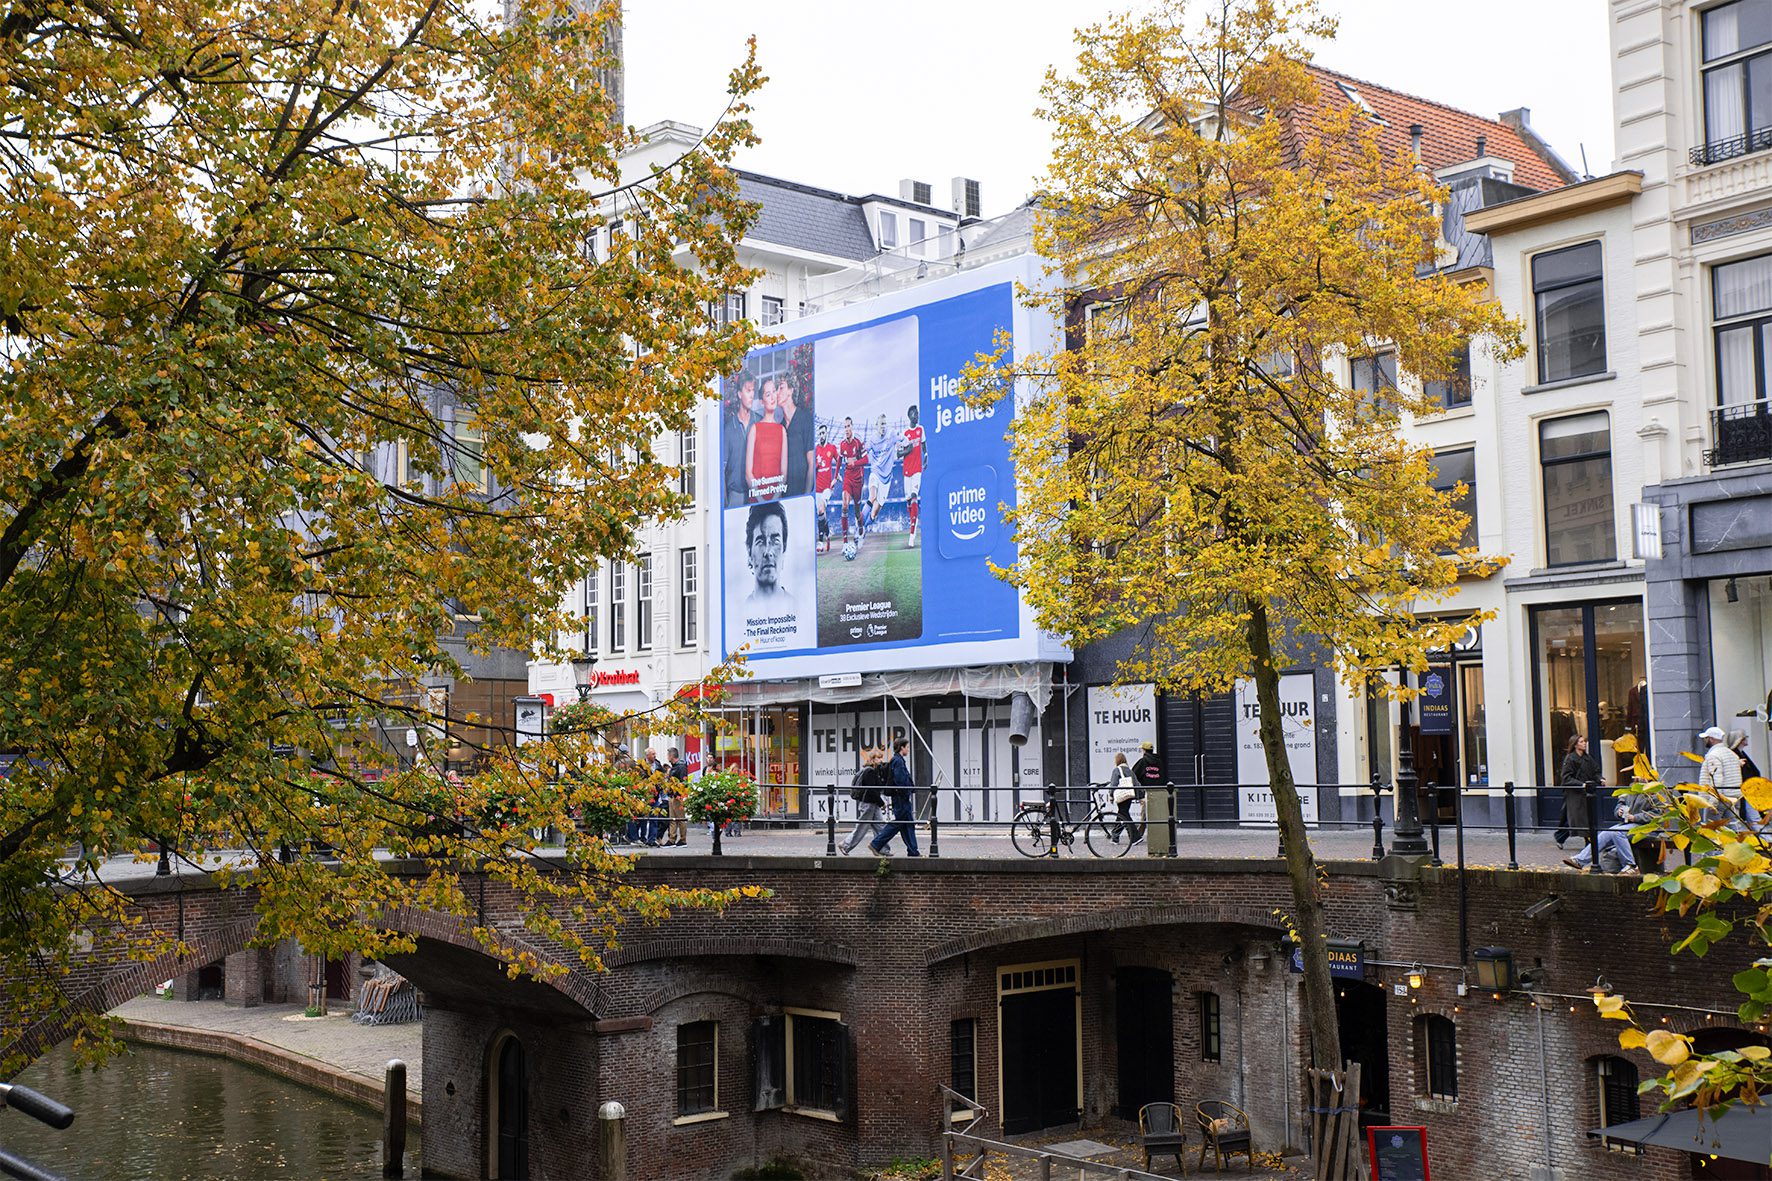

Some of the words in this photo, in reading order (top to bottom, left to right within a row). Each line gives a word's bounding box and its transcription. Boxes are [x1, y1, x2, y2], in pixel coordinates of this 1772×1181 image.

[935, 404, 952, 433] je
[751, 478, 761, 487] The
[761, 475, 785, 485] Summer
[752, 487, 769, 497] Turned
[770, 483, 788, 495] Pretty
[949, 486, 986, 509] prime
[950, 505, 986, 525] video
[846, 602, 869, 612] Premier
[870, 601, 892, 611] League
[746, 617, 768, 626] Mission:
[768, 614, 796, 625] Impossible
[746, 628, 757, 636] The
[757, 626, 770, 636] Final
[770, 625, 797, 635] Reckoning
[600, 669, 640, 684] Kruidvat
[1094, 710, 1110, 724] TE
[1112, 708, 1152, 724] HUUR
[1243, 704, 1261, 718] TE
[813, 729, 837, 753] TE
[1294, 741, 1311, 749] grond
[1022, 768, 1040, 776] CBRE
[1328, 951, 1357, 963] DIAAS
[1328, 963, 1357, 971] TAURANT
